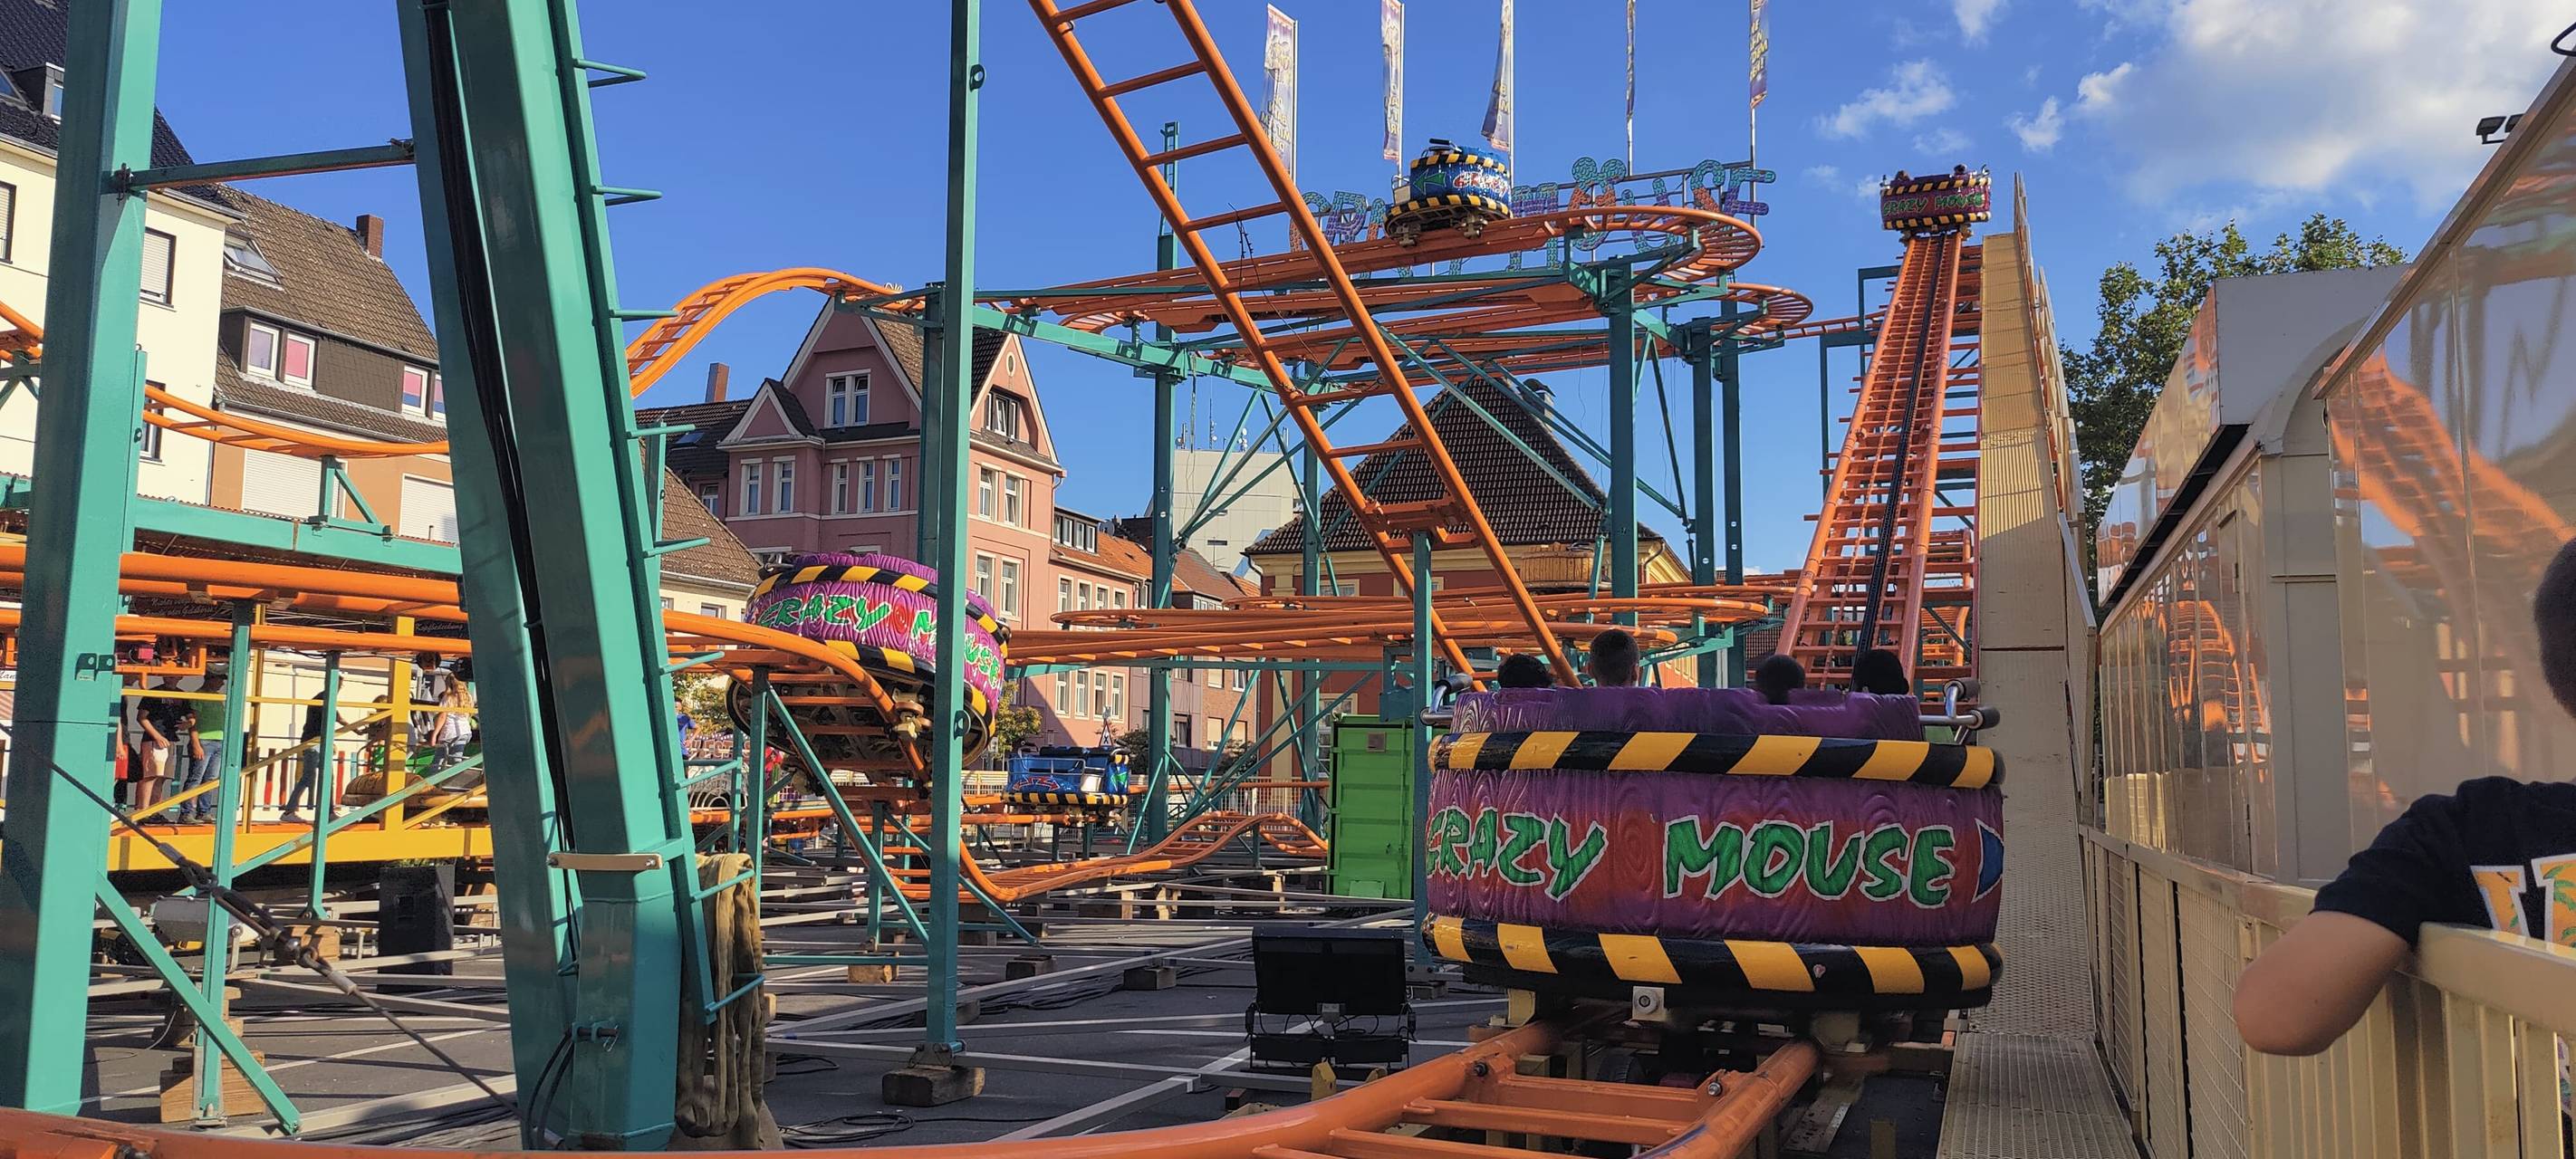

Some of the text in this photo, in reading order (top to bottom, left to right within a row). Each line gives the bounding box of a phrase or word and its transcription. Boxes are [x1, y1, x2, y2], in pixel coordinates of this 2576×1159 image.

[1882, 192, 1985, 216] CRAZY MOUSE
[758, 593, 1005, 689] CRAZY MUSE
[1426, 805, 1956, 909] CRAZY MOUSE
